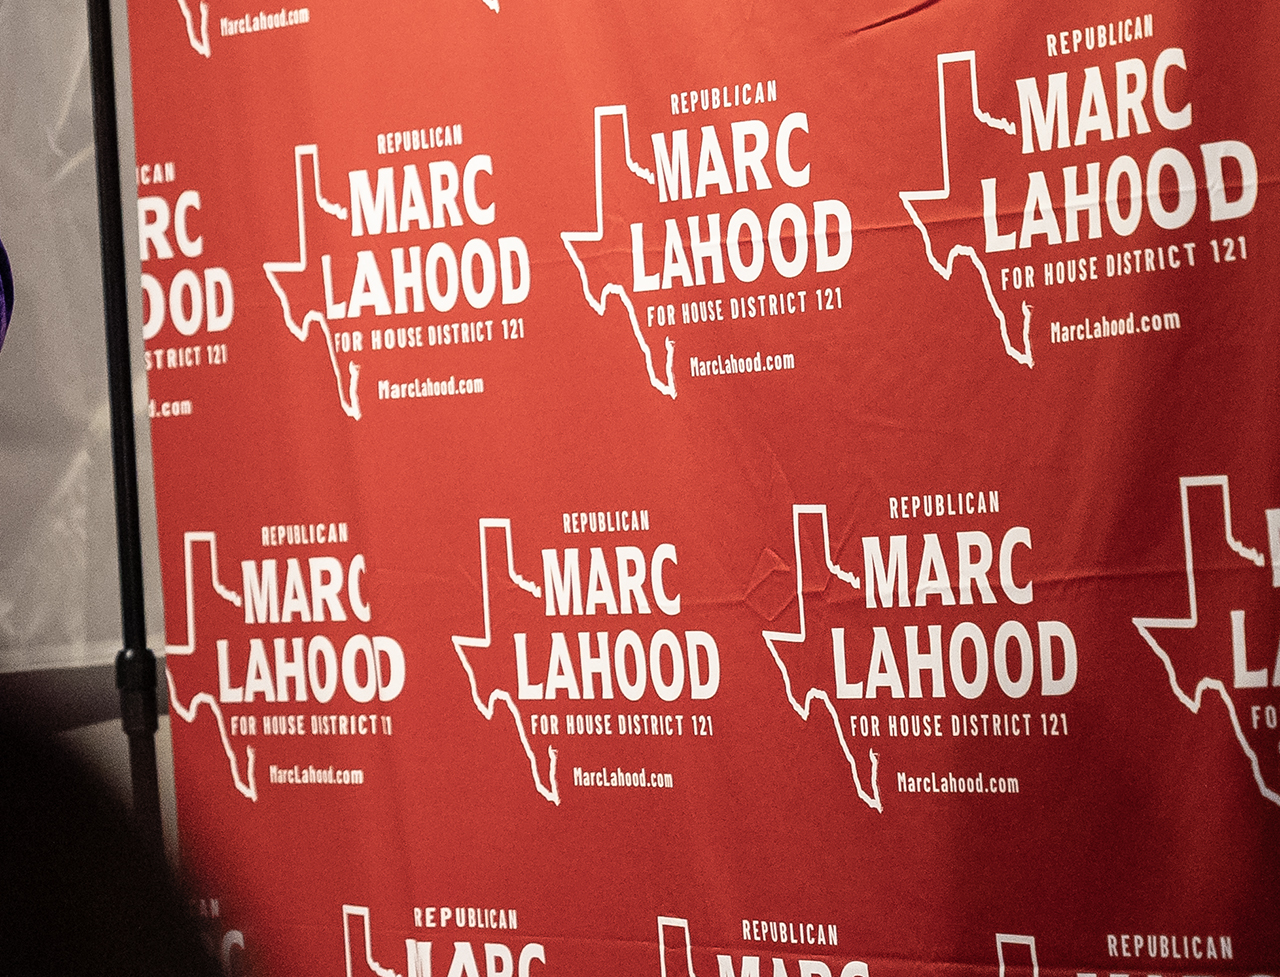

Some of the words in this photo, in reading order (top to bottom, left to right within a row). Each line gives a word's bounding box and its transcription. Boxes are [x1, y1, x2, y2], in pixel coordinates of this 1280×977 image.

[220, 7, 310, 36] MarcLahood.com
[1046, 14, 1153, 57] REPUBLICAN
[670, 79, 777, 115] REPUBLICAN
[1016, 48, 1191, 154] MARC
[376, 124, 463, 155] REPUBLICAN
[651, 112, 810, 202] MARC
[349, 155, 495, 236] MARC
[981, 141, 1257, 252] LAHOOD
[630, 200, 852, 292] LAHOOD
[322, 237, 530, 319] LAHOOD
[1001, 265, 1035, 291] FOR
[1044, 256, 1098, 286] HOUSE
[1106, 242, 1196, 278] DISTRICT
[1210, 236, 1247, 263] 121
[646, 304, 676, 328] FOR
[681, 299, 724, 324] HOUSE
[729, 290, 807, 320] DISTRICT
[815, 286, 842, 311] 121
[334, 330, 363, 353] FOR
[370, 326, 423, 350] HOUSE
[427, 320, 494, 346] DISTRICT
[501, 317, 525, 340] 121
[1050, 312, 1180, 344] MarcLahood.com
[207, 343, 228, 365] 121
[689, 351, 795, 377] MarcLahood.com
[377, 376, 484, 400] MarcLahood.com
[562, 509, 650, 534] REPUBLICAN
[888, 490, 1000, 519] REPUBLICAN
[261, 522, 348, 546] REPUBLICAN
[542, 544, 680, 616] MARC
[862, 527, 1033, 608] MARC
[242, 555, 371, 623] MARC
[217, 634, 405, 703] LAHOOD
[514, 629, 720, 701] LAHOOD
[831, 621, 1077, 699] LAHOOD
[230, 715, 256, 735] FOR
[262, 715, 305, 735] HOUSE
[310, 714, 378, 737] DISTRICT
[530, 714, 559, 735] FOR
[565, 714, 613, 735] HOUSE
[617, 714, 684, 736] DISTRICT
[691, 714, 713, 736] 121
[850, 715, 881, 737] FOR
[888, 714, 943, 737] HOUSE
[951, 713, 1031, 737] DISTRICT
[1040, 713, 1068, 736] 121
[573, 767, 674, 788] MarcLahood.com
[896, 771, 1020, 793] MarcLahood.com
[413, 906, 518, 930] REPUBLICAN
[741, 919, 838, 946] REPUBLICAN
[1106, 934, 1234, 960] REPUBLICAN
